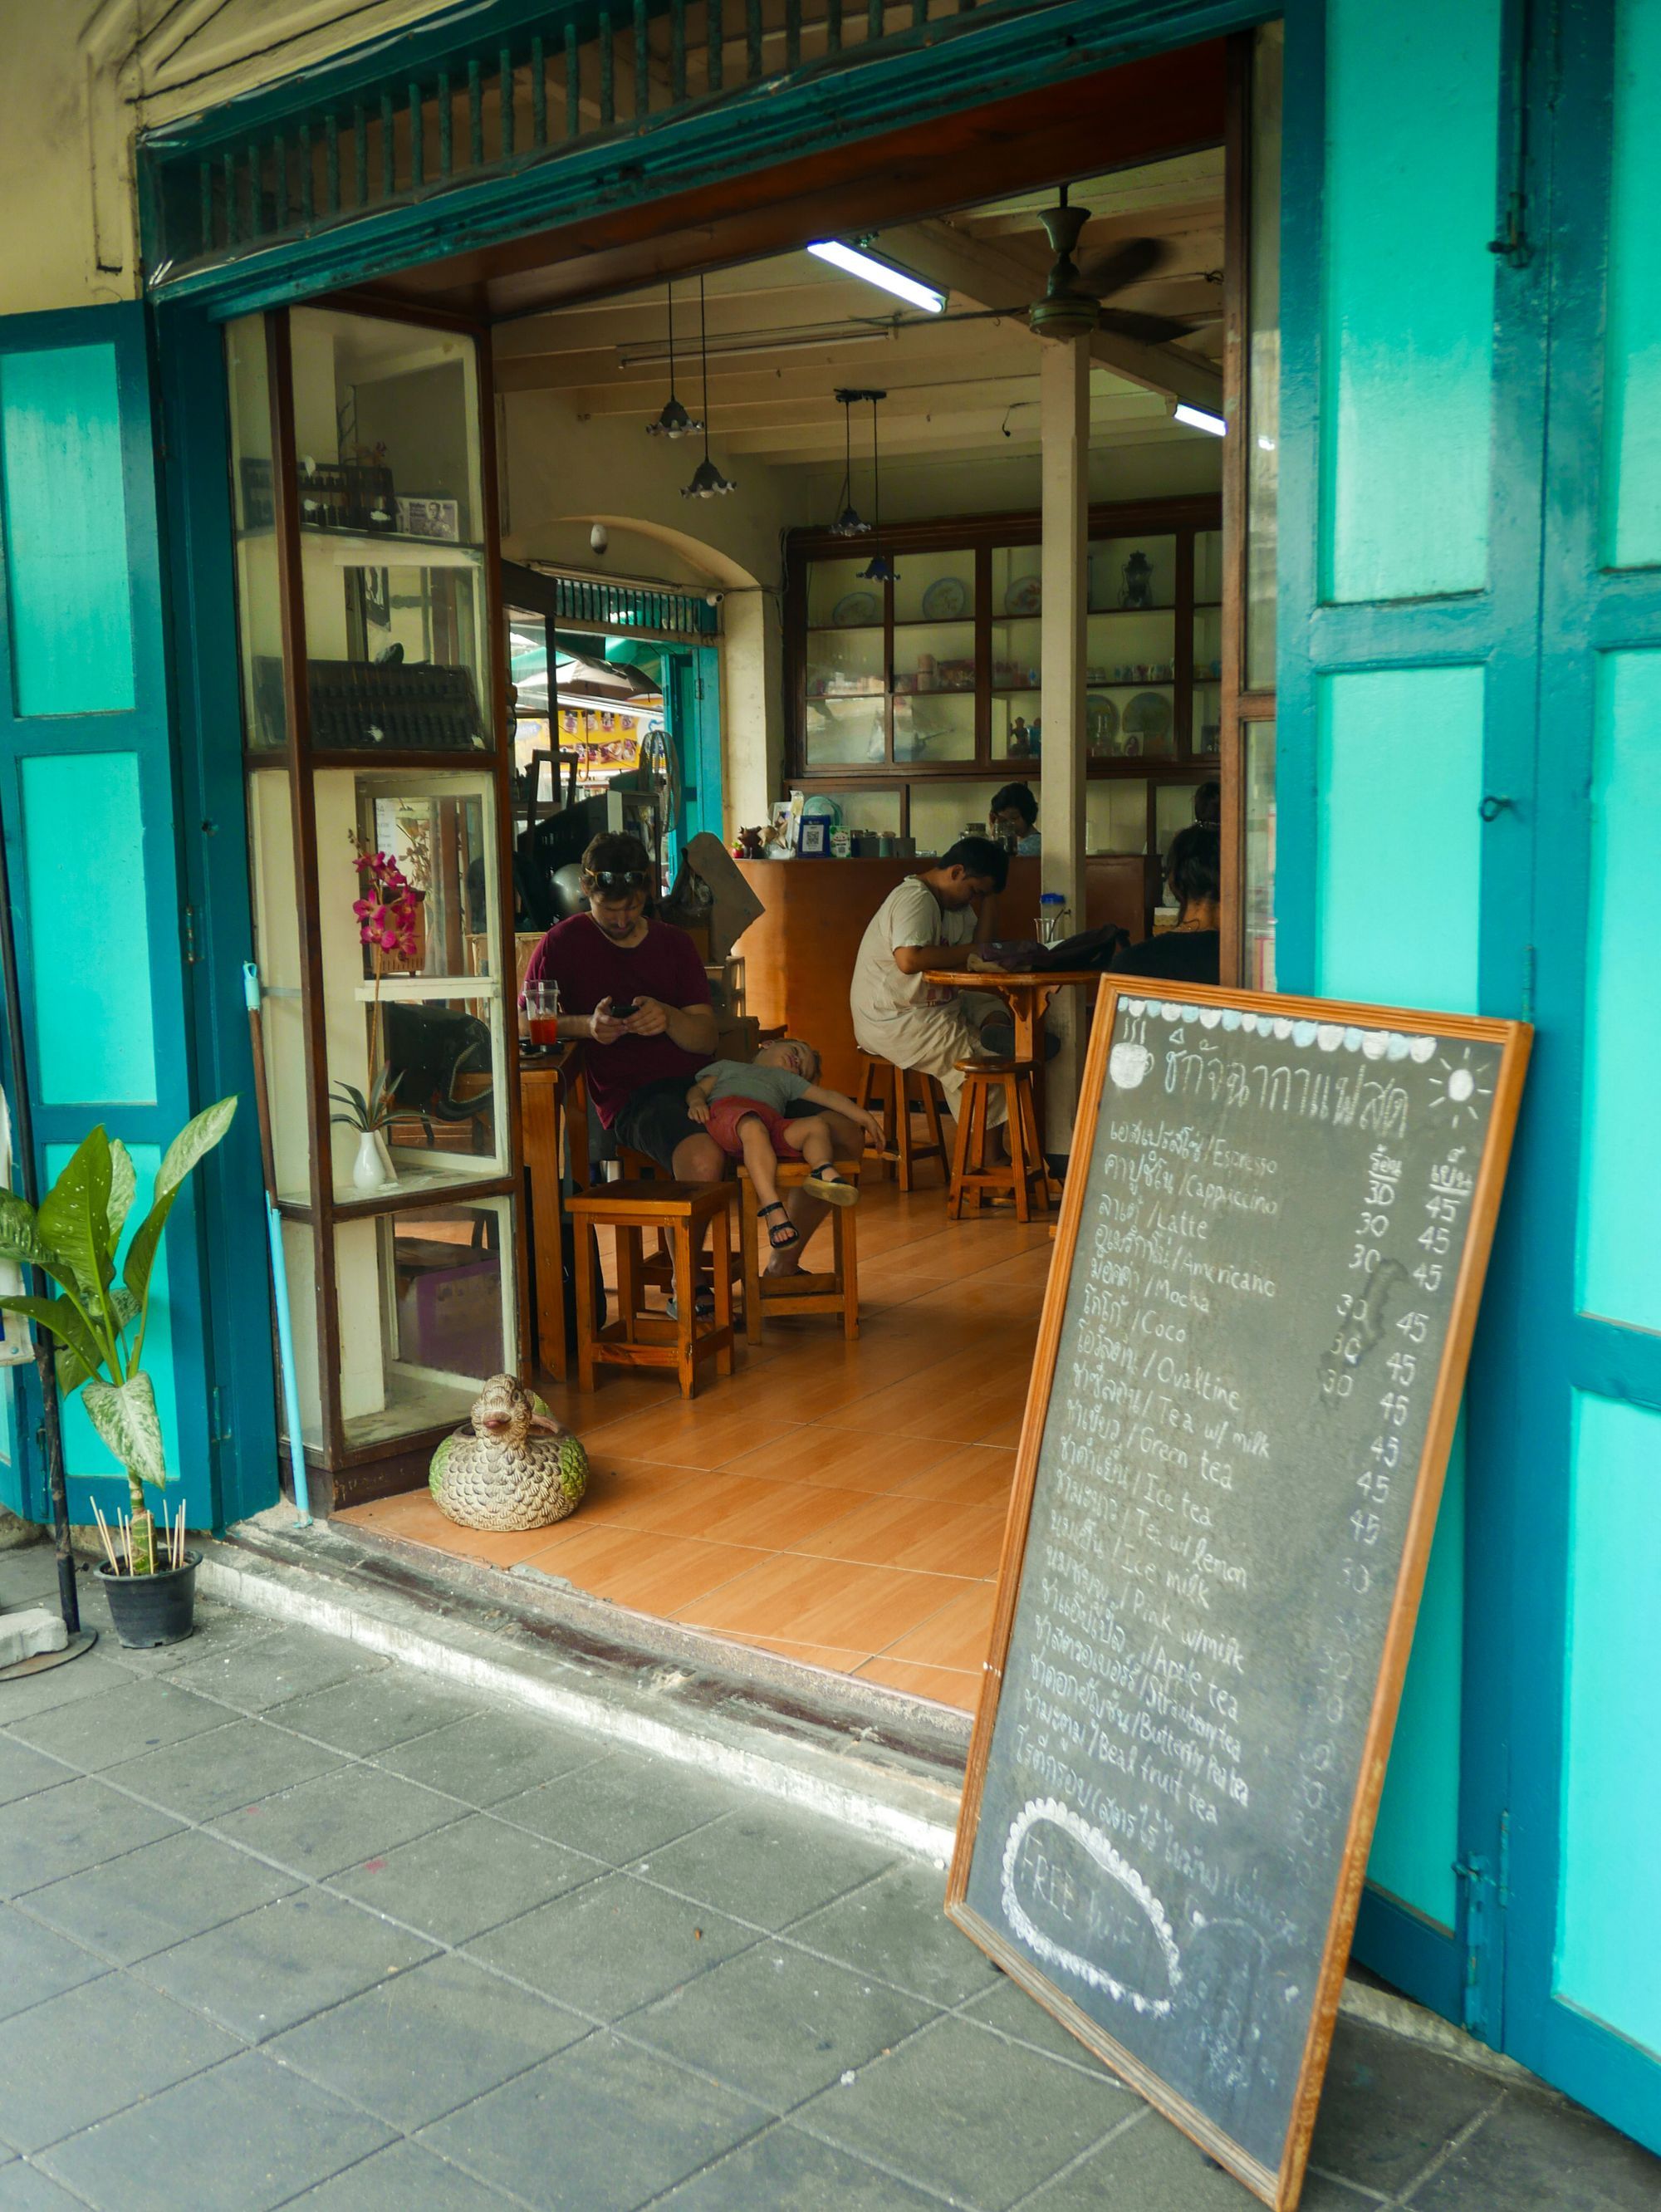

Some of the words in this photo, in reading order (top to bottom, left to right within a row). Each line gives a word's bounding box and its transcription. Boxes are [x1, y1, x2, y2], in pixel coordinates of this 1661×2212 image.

[1364, 1180, 1395, 1205] 30
[1425, 1194, 1461, 1223] 45
[1355, 1211, 1389, 1238] 30
[1417, 1225, 1451, 1255] 45
[1348, 1243, 1381, 1273] 30
[1413, 1262, 1443, 1292] 45
[1336, 1293, 1368, 1320] 30
[1396, 1312, 1430, 1343] 45
[1322, 1369, 1354, 1397] 30
[1386, 1351, 1417, 1386] 45
[1379, 1391, 1409, 1426] 45
[1232, 1430, 1271, 1459] milk
[1370, 1435, 1400, 1468] 45
[1201, 1449, 1233, 1491] tea
[1356, 1470, 1390, 1503] 45
[1182, 1491, 1213, 1527] tea
[1350, 1509, 1380, 1546] 45
[1166, 1567, 1210, 1610] milk
[1208, 1676, 1239, 1724] tea
[1140, 1753, 1184, 1805] fruit
[1188, 1783, 1219, 1826] tea
[1020, 1830, 1075, 1922] FREE
